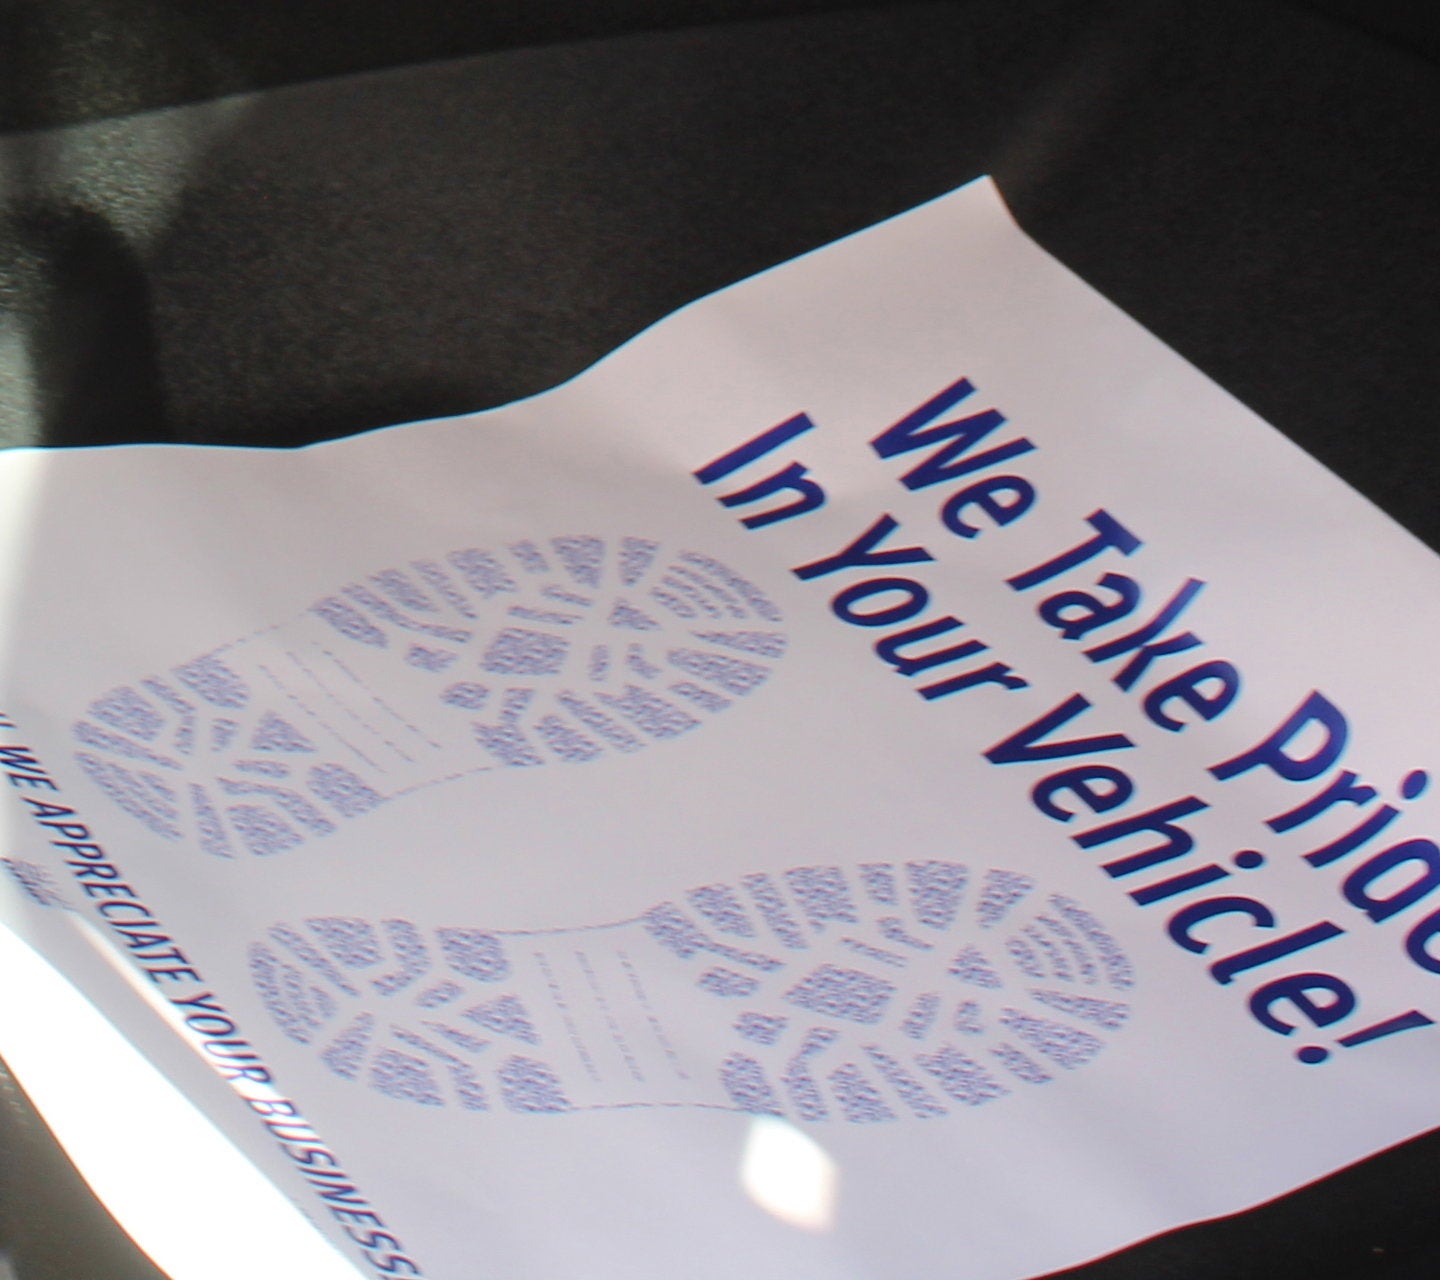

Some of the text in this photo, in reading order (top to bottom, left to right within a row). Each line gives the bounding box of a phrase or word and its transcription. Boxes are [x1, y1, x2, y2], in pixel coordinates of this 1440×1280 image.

[869, 376, 1039, 539] We
[1005, 509, 1241, 733] Take
[693, 411, 1437, 1066] In Your Vehicle!
[21, 797, 205, 984] APPRECIATE
[170, 992, 276, 1084] YOUR
